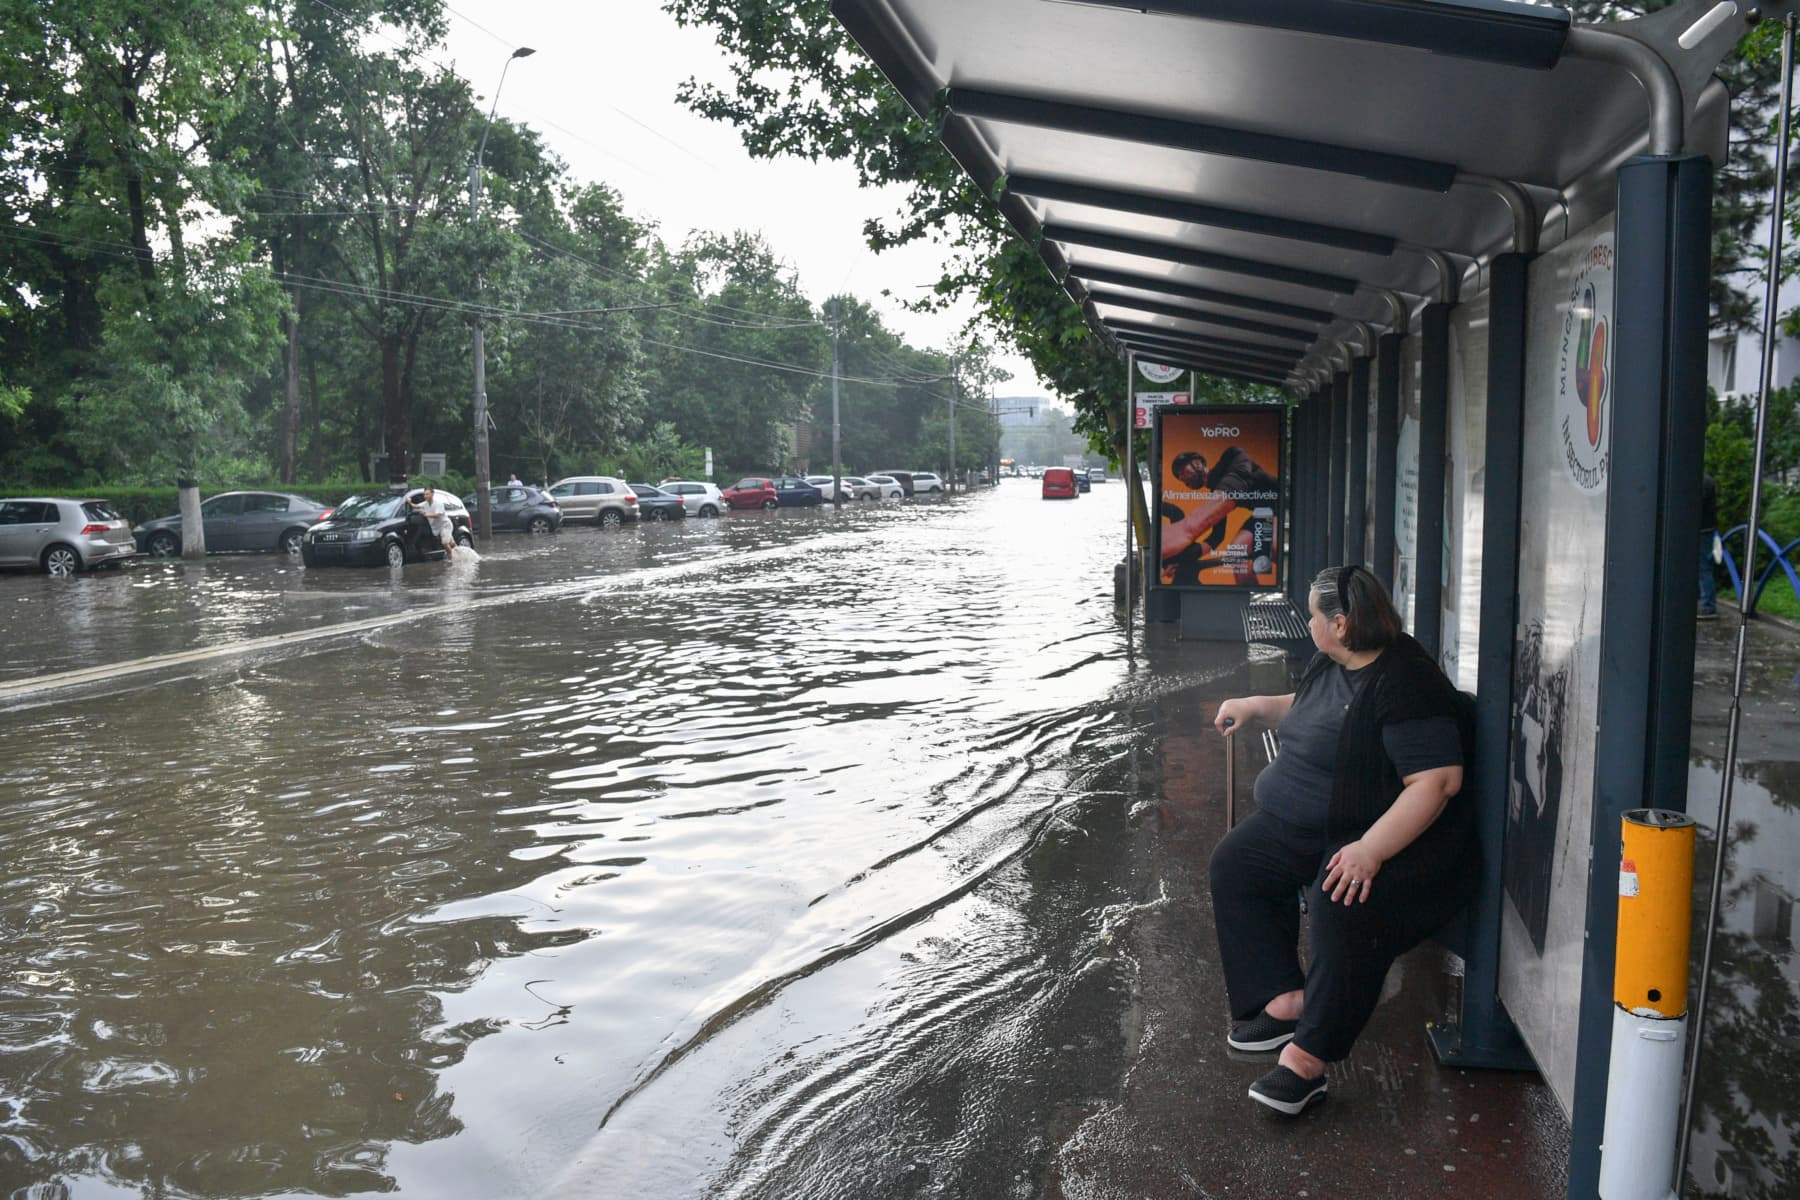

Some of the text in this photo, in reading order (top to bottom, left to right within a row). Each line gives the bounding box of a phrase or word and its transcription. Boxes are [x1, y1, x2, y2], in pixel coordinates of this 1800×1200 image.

[1560, 244, 1612, 395] MUNCESC IUBESC
[1201, 427, 1240, 437] YoPRO
[1566, 441, 1599, 489] SECTORUL
[1228, 490, 1278, 500] obiectivele
[1254, 522, 1263, 552] YoPRO
